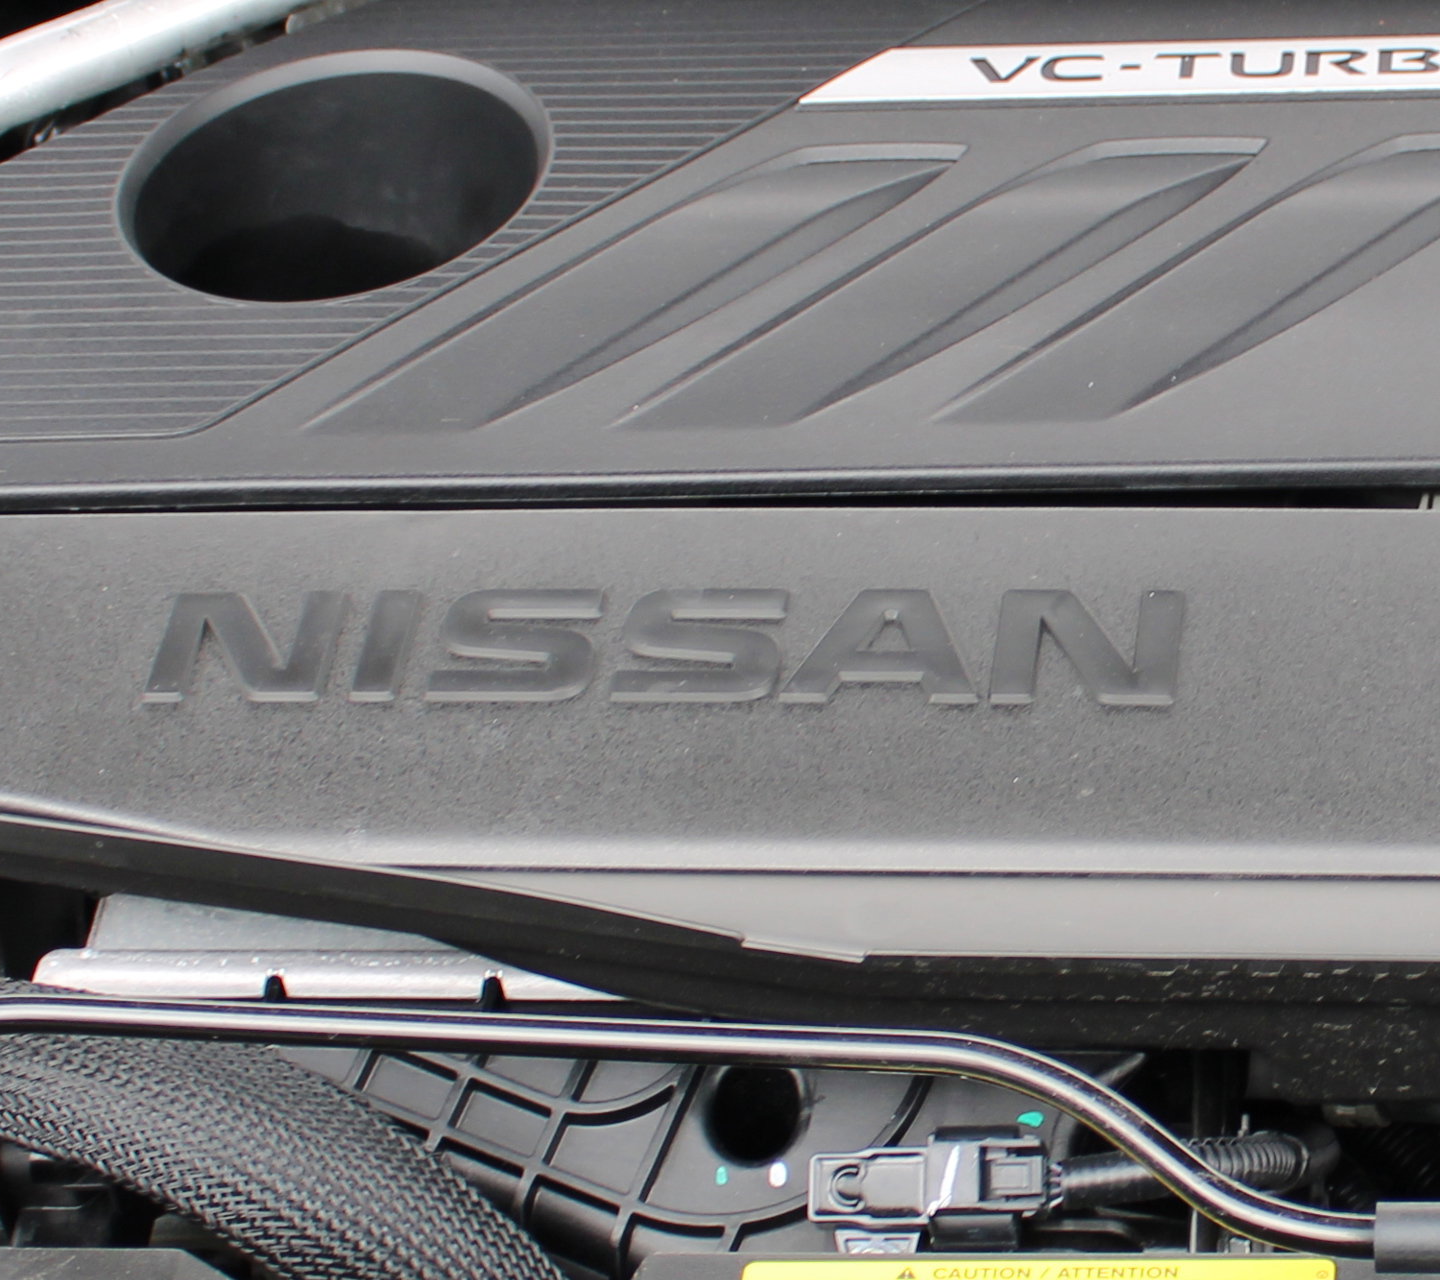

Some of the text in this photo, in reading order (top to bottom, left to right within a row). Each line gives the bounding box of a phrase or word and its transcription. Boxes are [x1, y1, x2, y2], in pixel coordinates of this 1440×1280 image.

[142, 588, 1185, 706] NISSAN
[933, 1267, 1032, 1280] CAUTION
[1057, 1267, 1180, 1279] ATTENTION
